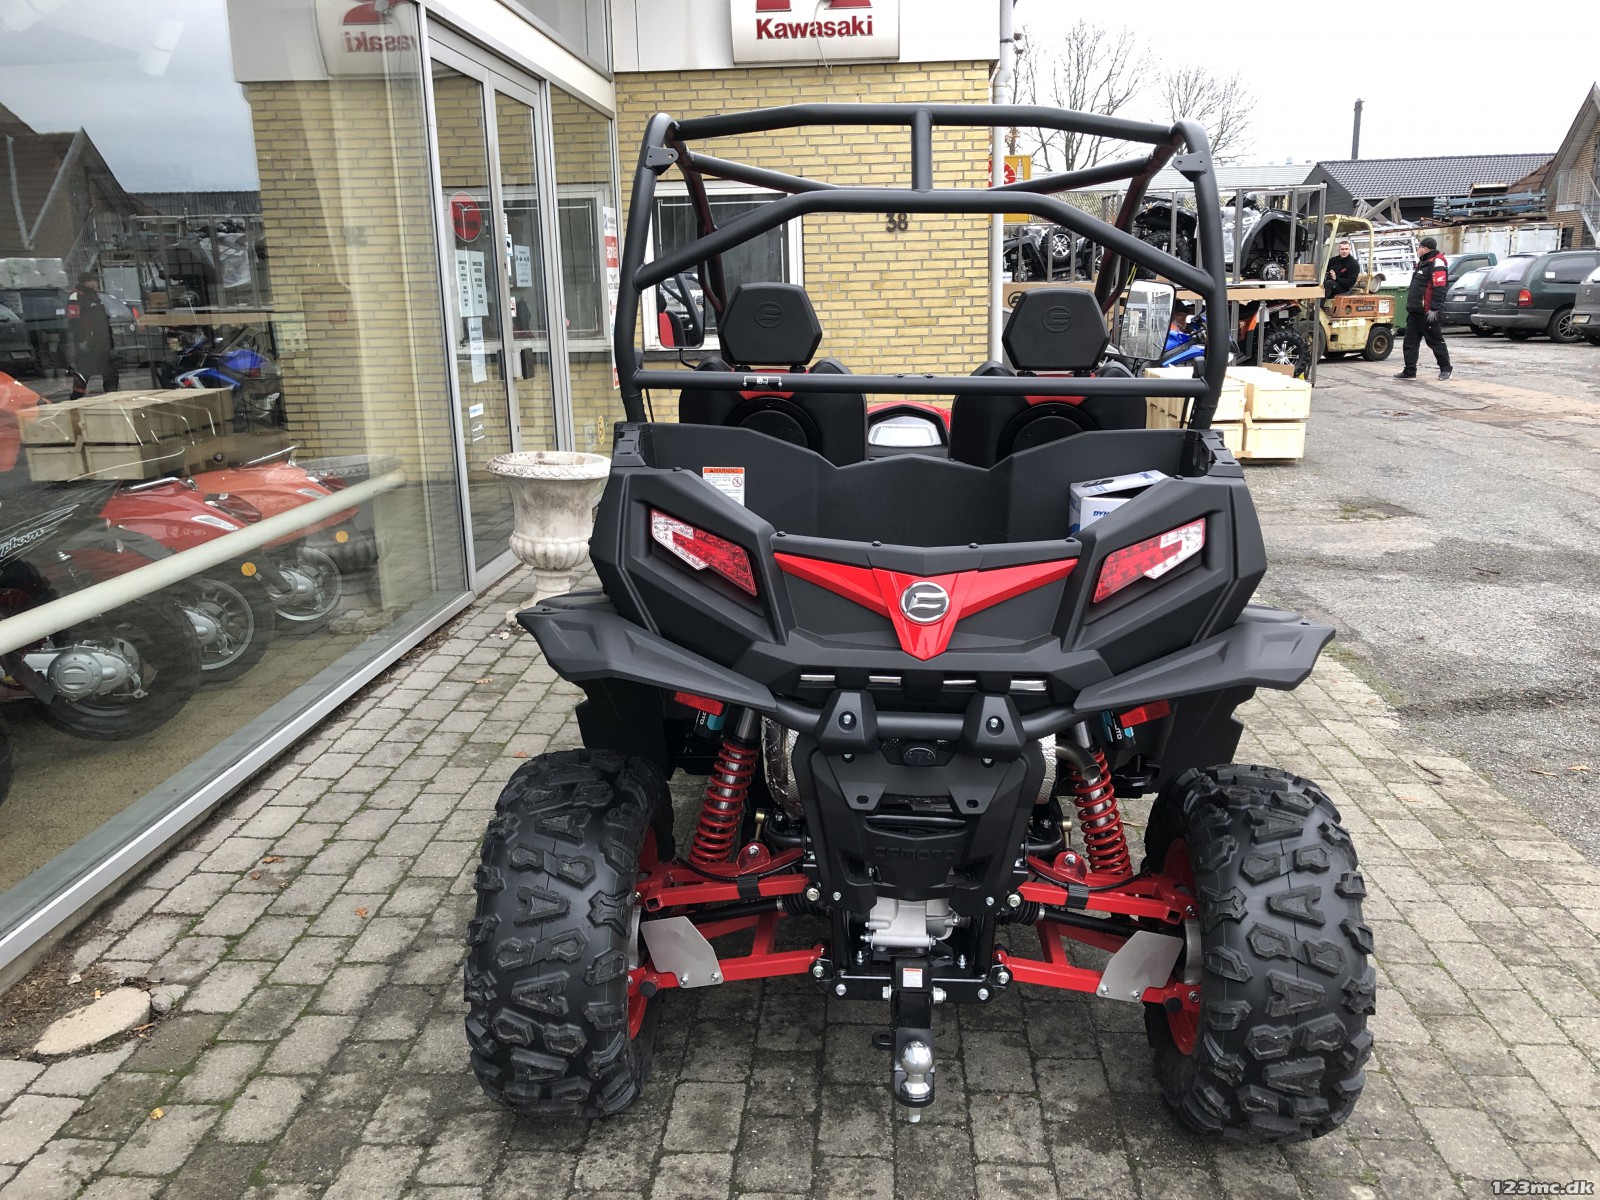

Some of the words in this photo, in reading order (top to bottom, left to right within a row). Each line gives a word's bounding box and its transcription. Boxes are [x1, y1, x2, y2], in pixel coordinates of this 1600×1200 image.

[756, 14, 873, 40] Kawasaki
[886, 212, 909, 233] 38
[0, 527, 46, 558] phoon
